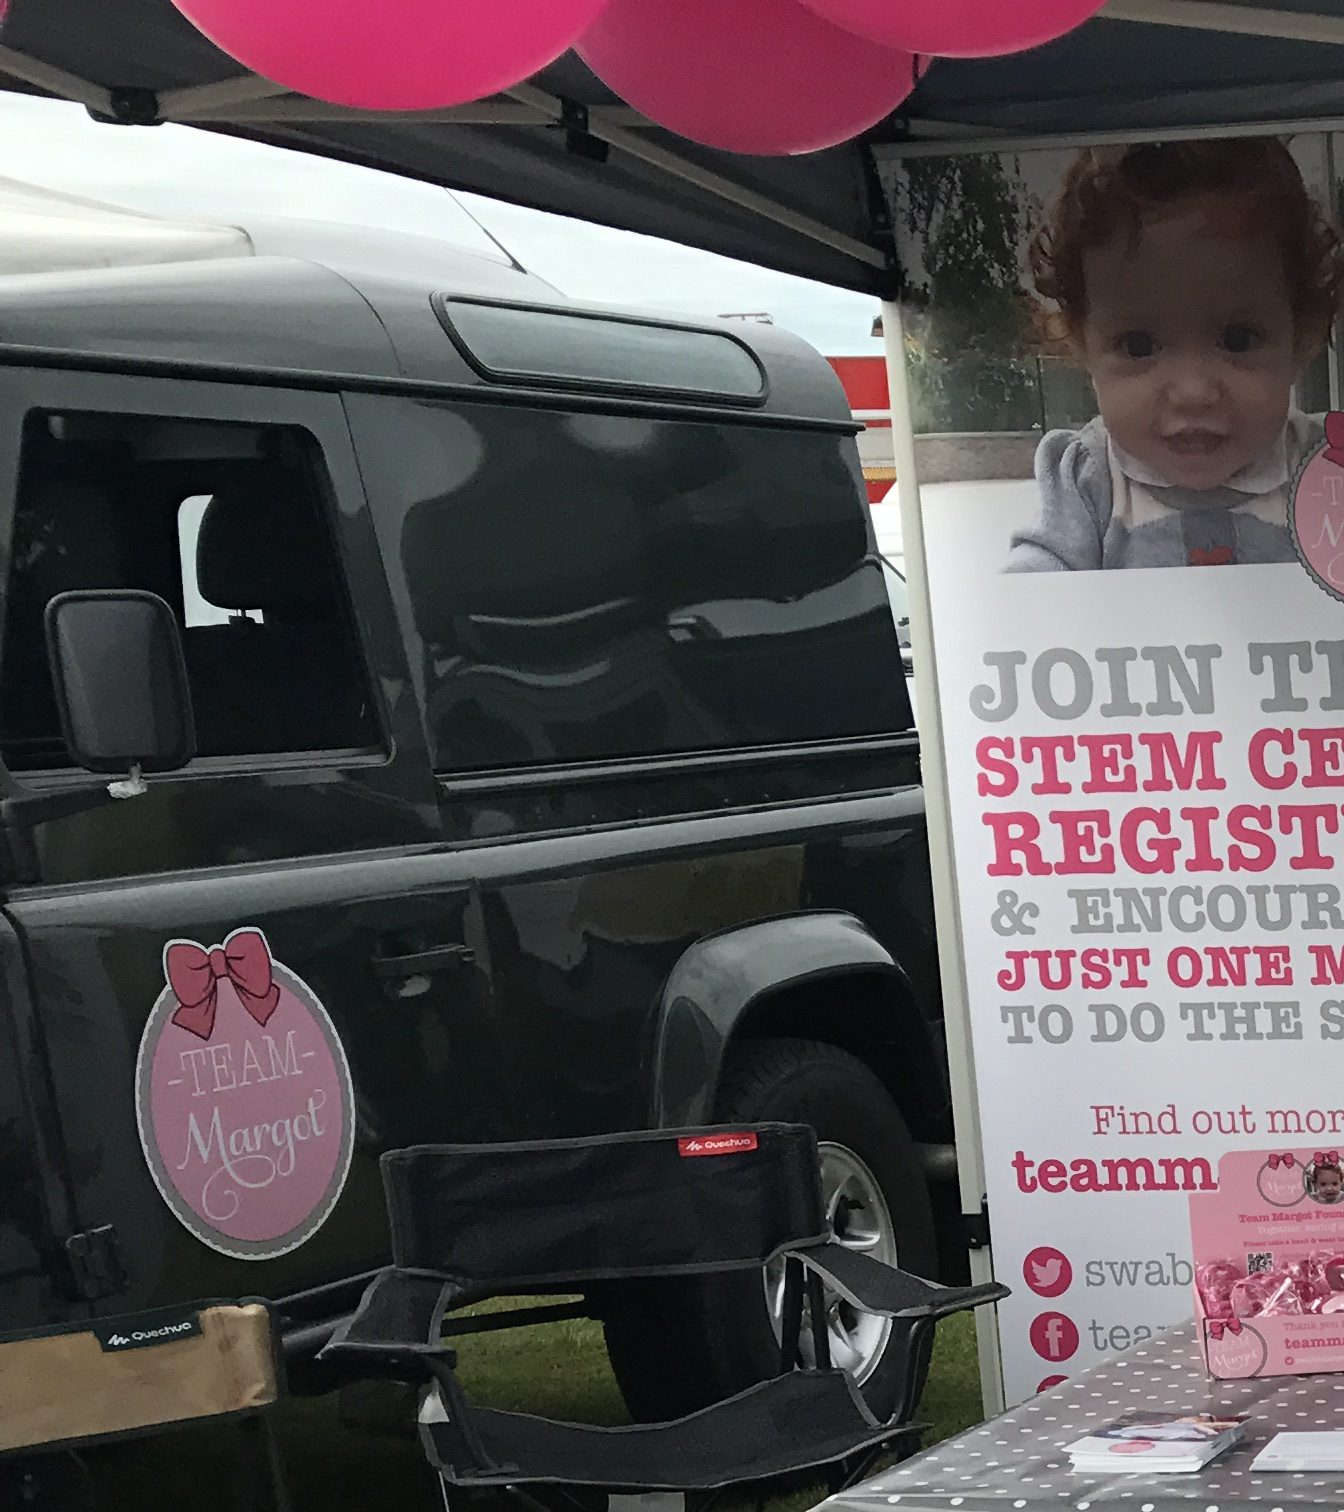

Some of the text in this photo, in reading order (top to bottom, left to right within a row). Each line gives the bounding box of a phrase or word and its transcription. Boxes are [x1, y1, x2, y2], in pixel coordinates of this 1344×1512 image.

[969, 644, 1221, 721] JOIN
[975, 731, 1226, 797] STEM
[991, 890, 1039, 935] &
[997, 948, 1150, 991] JUST
[1167, 946, 1293, 988] ONE
[1001, 1005, 1073, 1043] TO
[1088, 1002, 1165, 1042] DO
[1179, 1001, 1301, 1041] THE
[1090, 1105, 1182, 1136] Find
[1192, 1107, 1256, 1134] out
[177, 1089, 326, 1221] Margot
[1238, 1213, 1270, 1223] Team
[1272, 1211, 1312, 1222] Margot
[131, 1322, 192, 1340] Quechua
